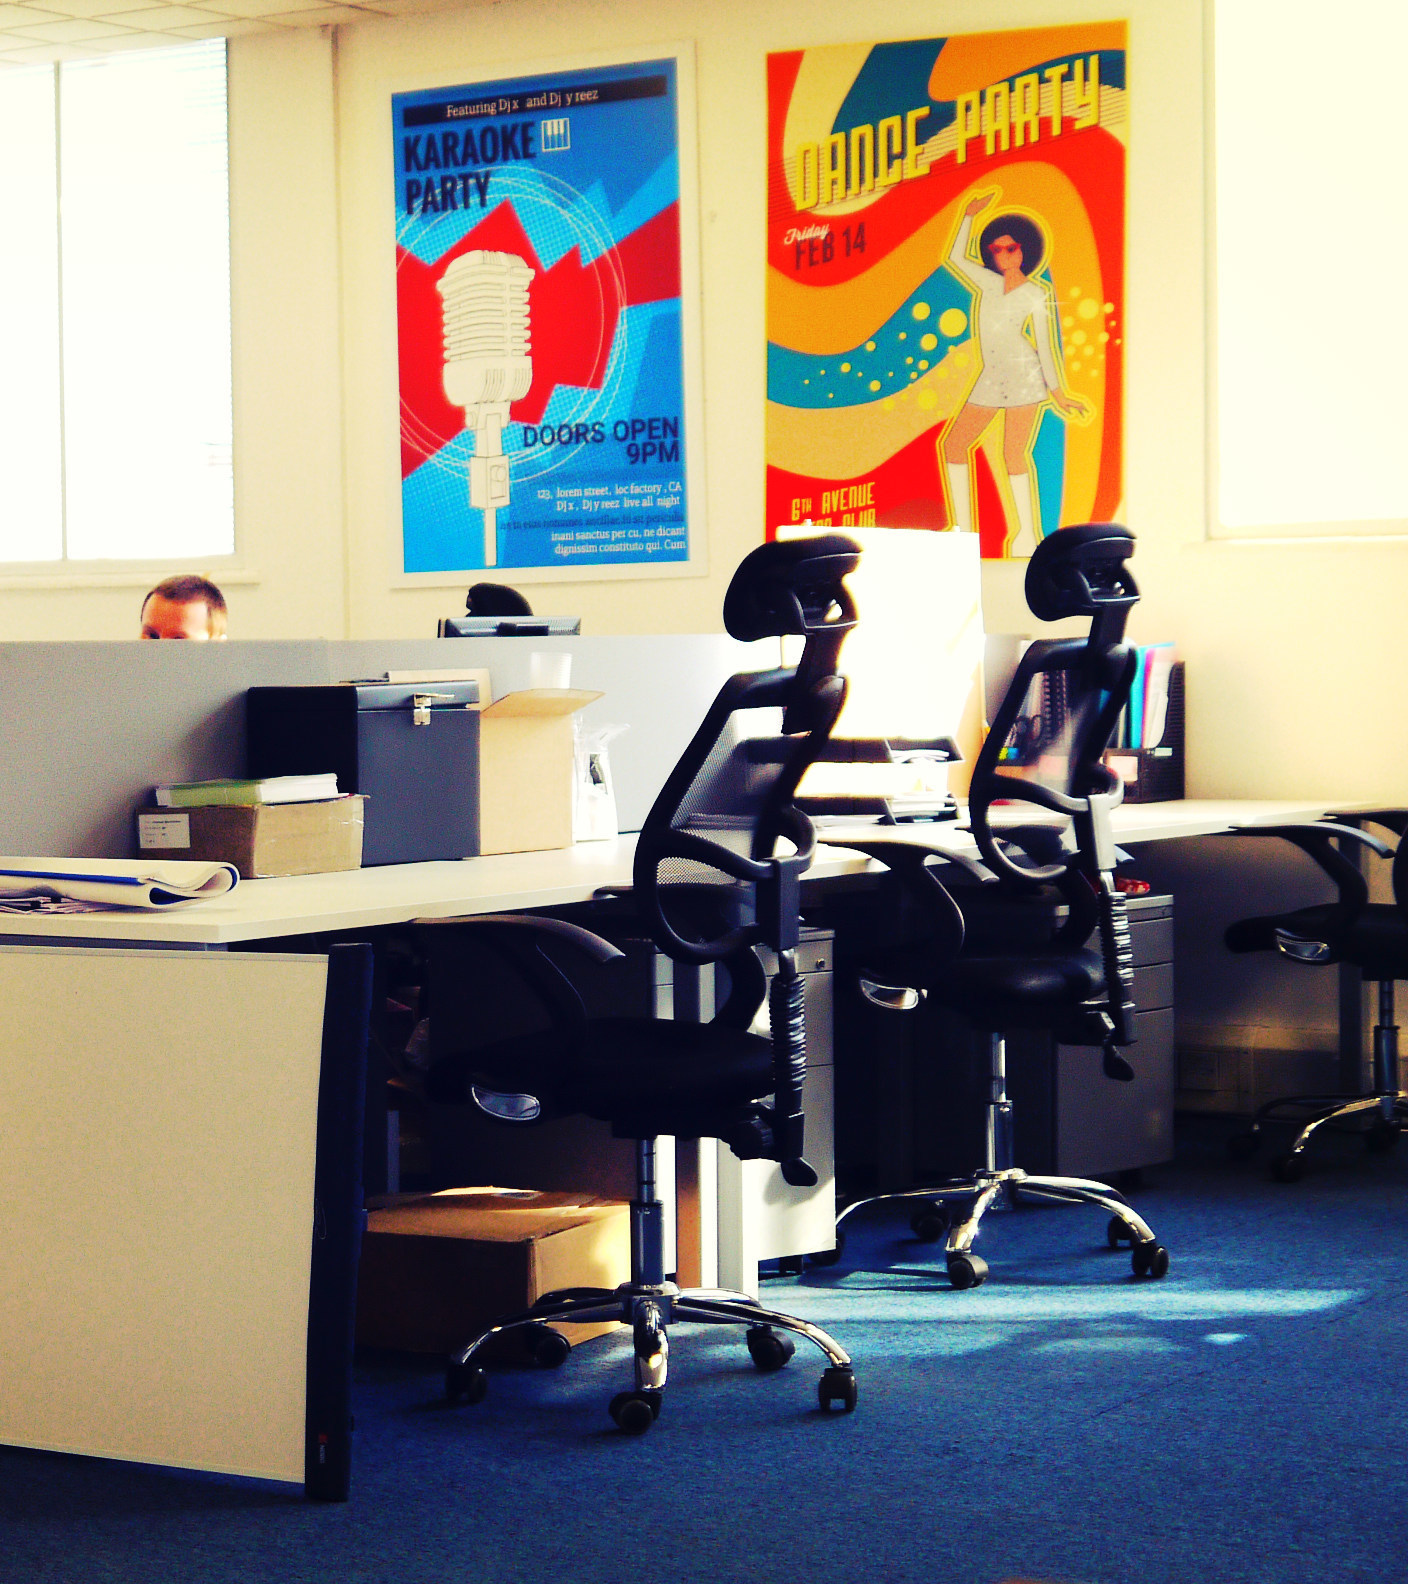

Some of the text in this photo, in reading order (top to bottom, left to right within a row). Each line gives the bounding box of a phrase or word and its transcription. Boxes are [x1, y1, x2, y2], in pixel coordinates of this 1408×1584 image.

[446, 101, 497, 118] Featuring
[526, 93, 547, 108] and
[795, 53, 1100, 212] DANCE PARTY
[403, 121, 537, 172] KARAOKE
[406, 170, 492, 215] PARTY
[784, 223, 830, 245] Friday
[796, 222, 866, 270] FEB 14
[523, 416, 679, 448] DOORS OPEN
[626, 439, 680, 465] 9PM
[557, 487, 582, 498] lorem
[668, 481, 682, 492] CA
[623, 497, 640, 508] live
[642, 496, 654, 507] all
[657, 494, 680, 508] night
[792, 482, 875, 521] 6TH AVENUE
[575, 529, 610, 540] sanctus
[644, 528, 655, 537] ne
[554, 543, 598, 556] dignissim
[599, 542, 644, 553] constituto
